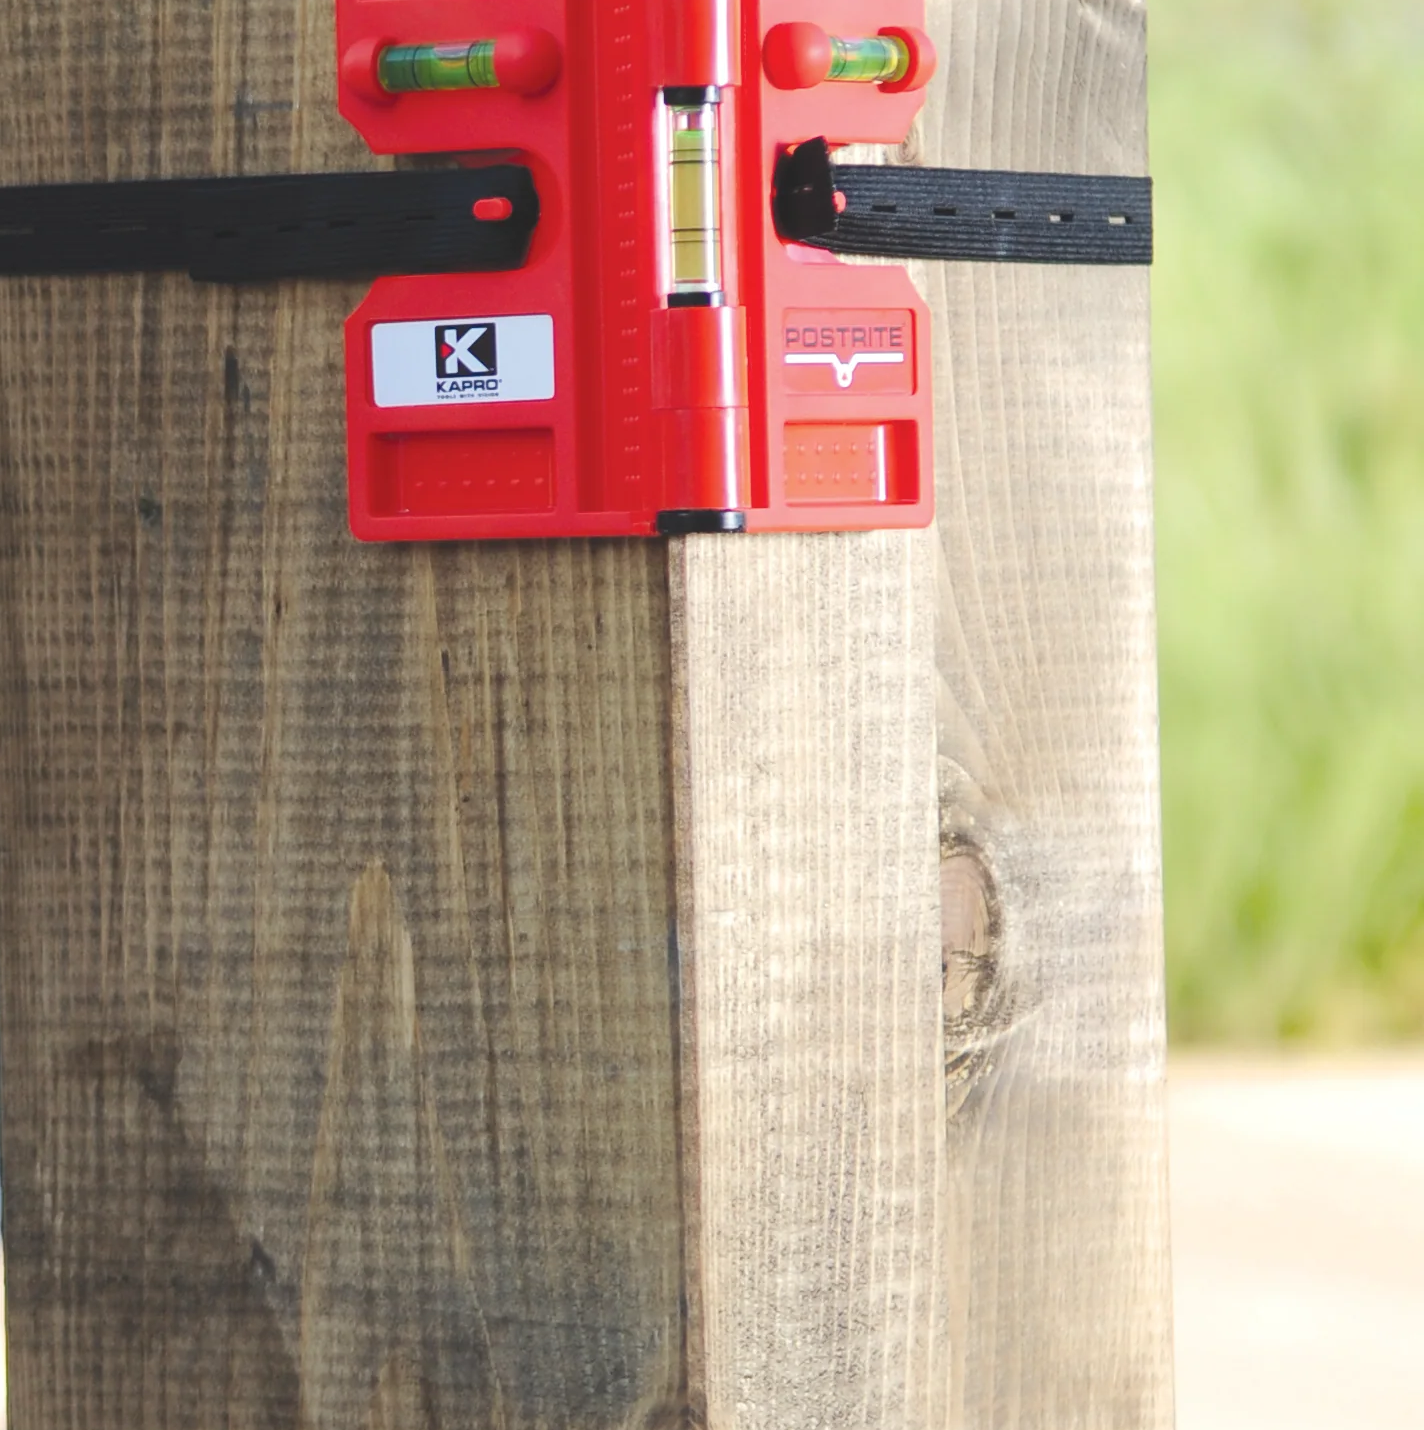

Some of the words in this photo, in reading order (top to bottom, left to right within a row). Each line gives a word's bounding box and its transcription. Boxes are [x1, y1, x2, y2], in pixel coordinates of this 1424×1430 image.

[785, 326, 904, 348] POSTRITE
[444, 327, 489, 374] K
[436, 379, 500, 393] KAPRO
